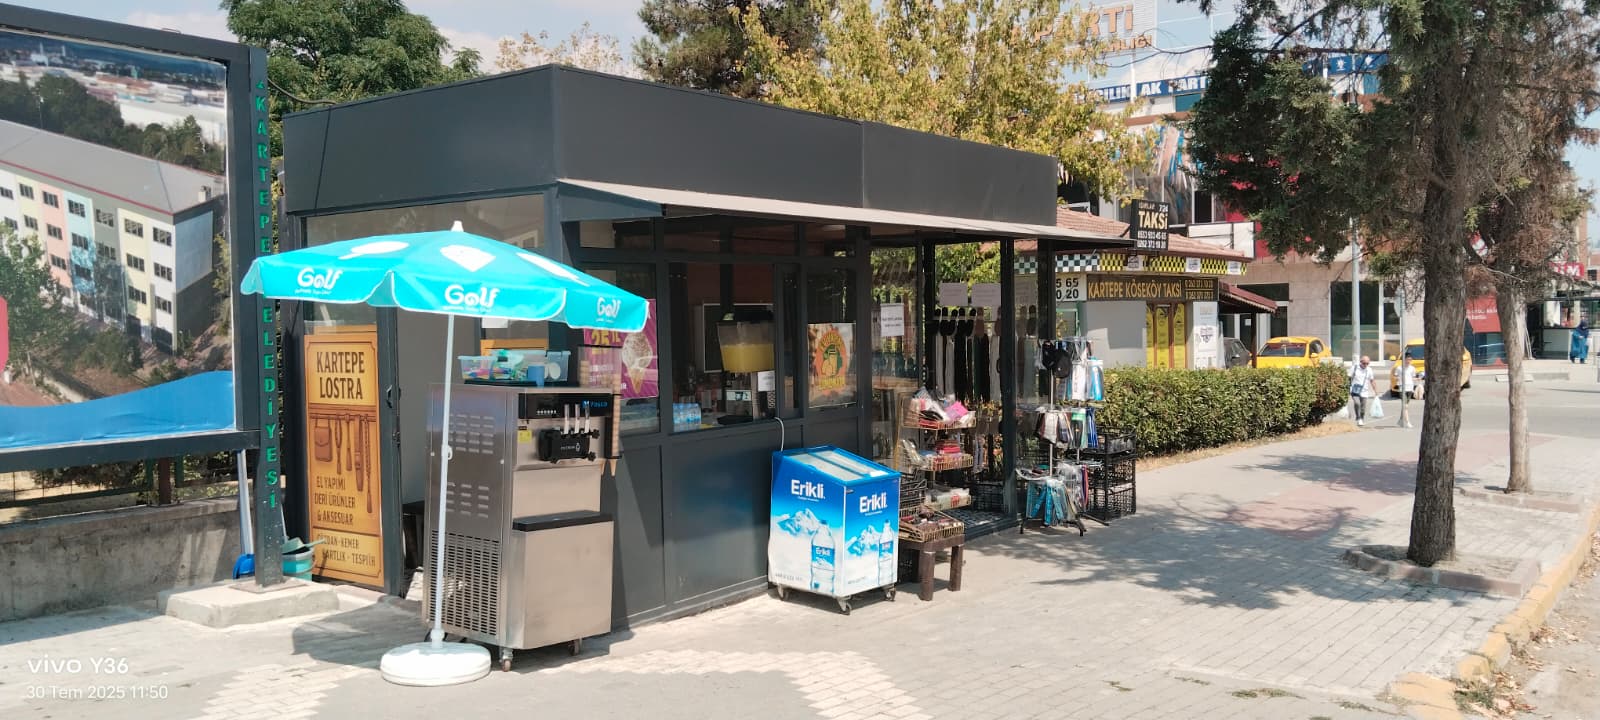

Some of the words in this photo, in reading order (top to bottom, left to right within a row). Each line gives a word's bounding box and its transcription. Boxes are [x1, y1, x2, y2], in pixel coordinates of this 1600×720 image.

[256, 96, 271, 253] KARTEPE
[297, 267, 343, 290] Golf
[1065, 277, 1079, 288] 65
[1088, 281, 1123, 299] KARTEPE
[1125, 278, 1162, 298] KÖSEKÖY
[444, 283, 501, 309] Golf
[1065, 289, 1079, 299] 20
[316, 351, 365, 374] KARTEPE
[319, 377, 364, 400] LOSTRA
[262, 305, 278, 509] ELEDİYESİ
[316, 475, 323, 489] EL
[791, 479, 825, 499] Erikli
[860, 492, 887, 513] Erikli
